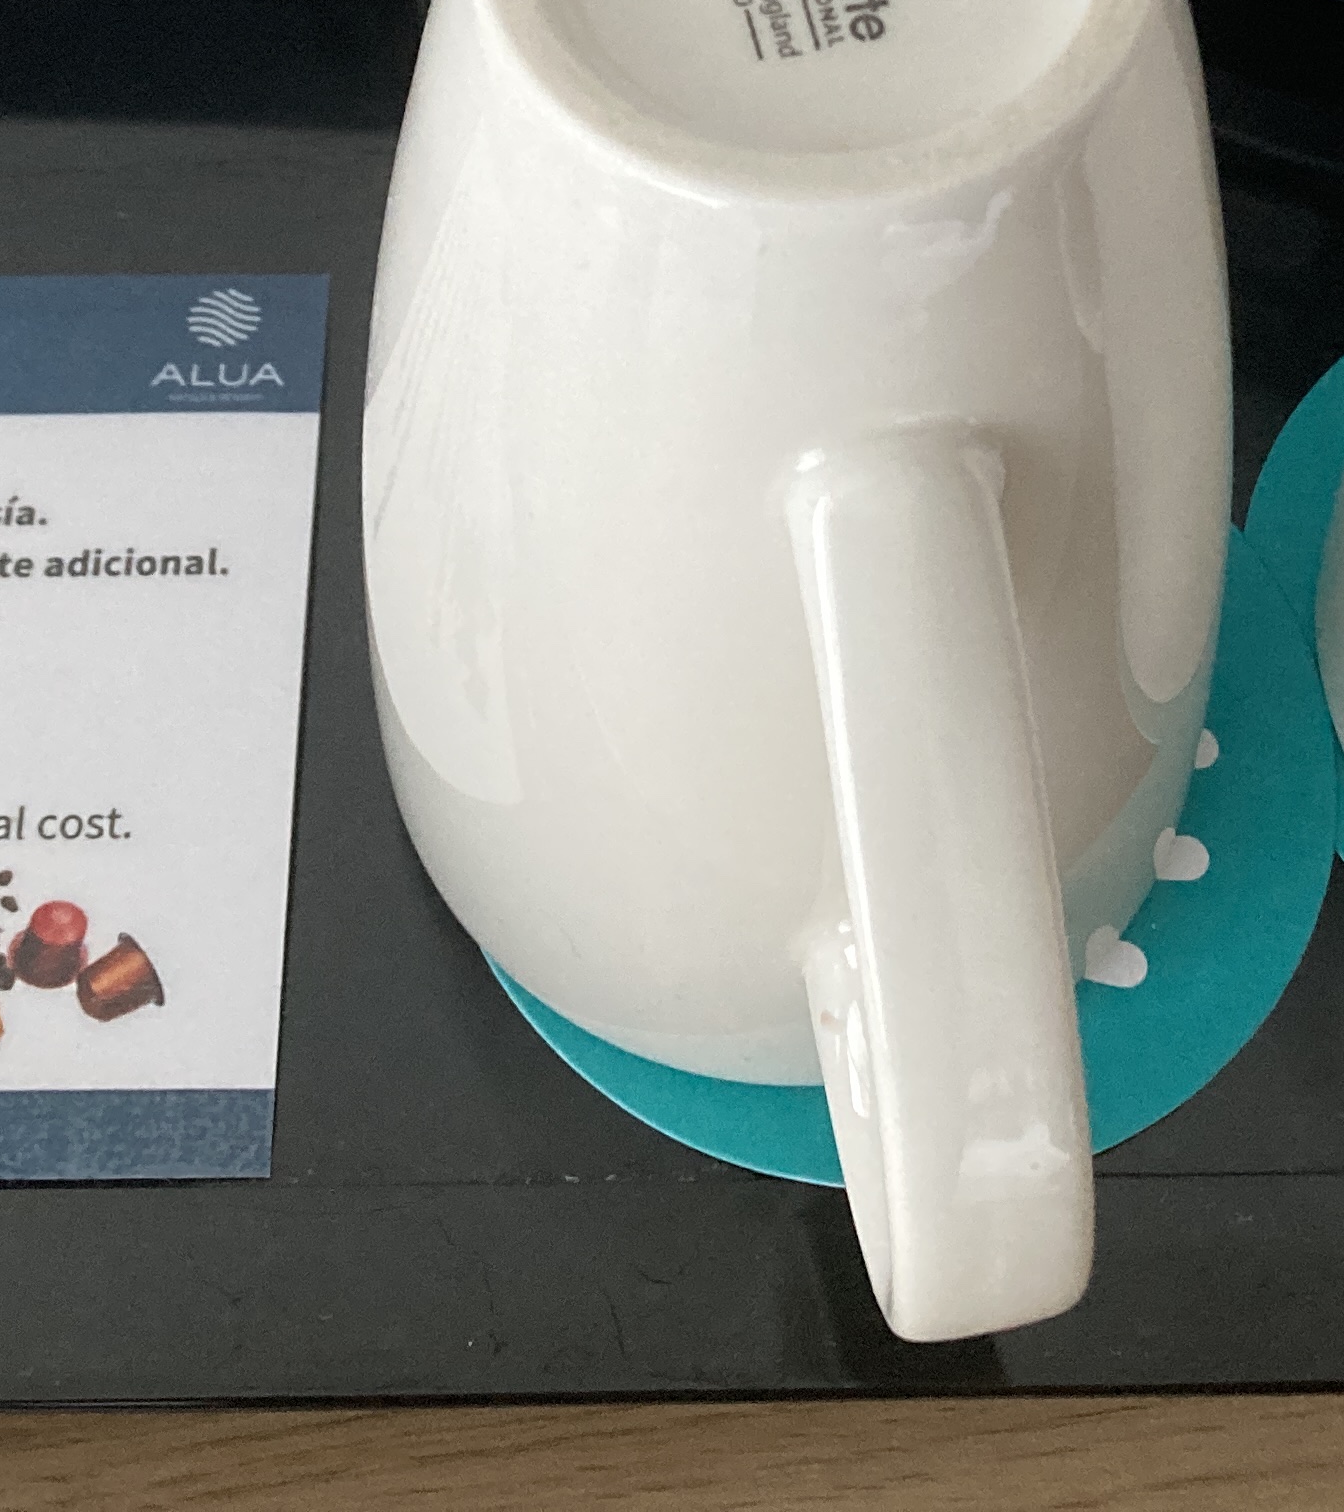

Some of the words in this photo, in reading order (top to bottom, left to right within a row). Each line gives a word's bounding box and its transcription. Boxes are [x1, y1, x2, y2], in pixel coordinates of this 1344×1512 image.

[149, 361, 286, 387] ALUA
[43, 547, 229, 578] adicional.
[37, 807, 131, 841] cost.
